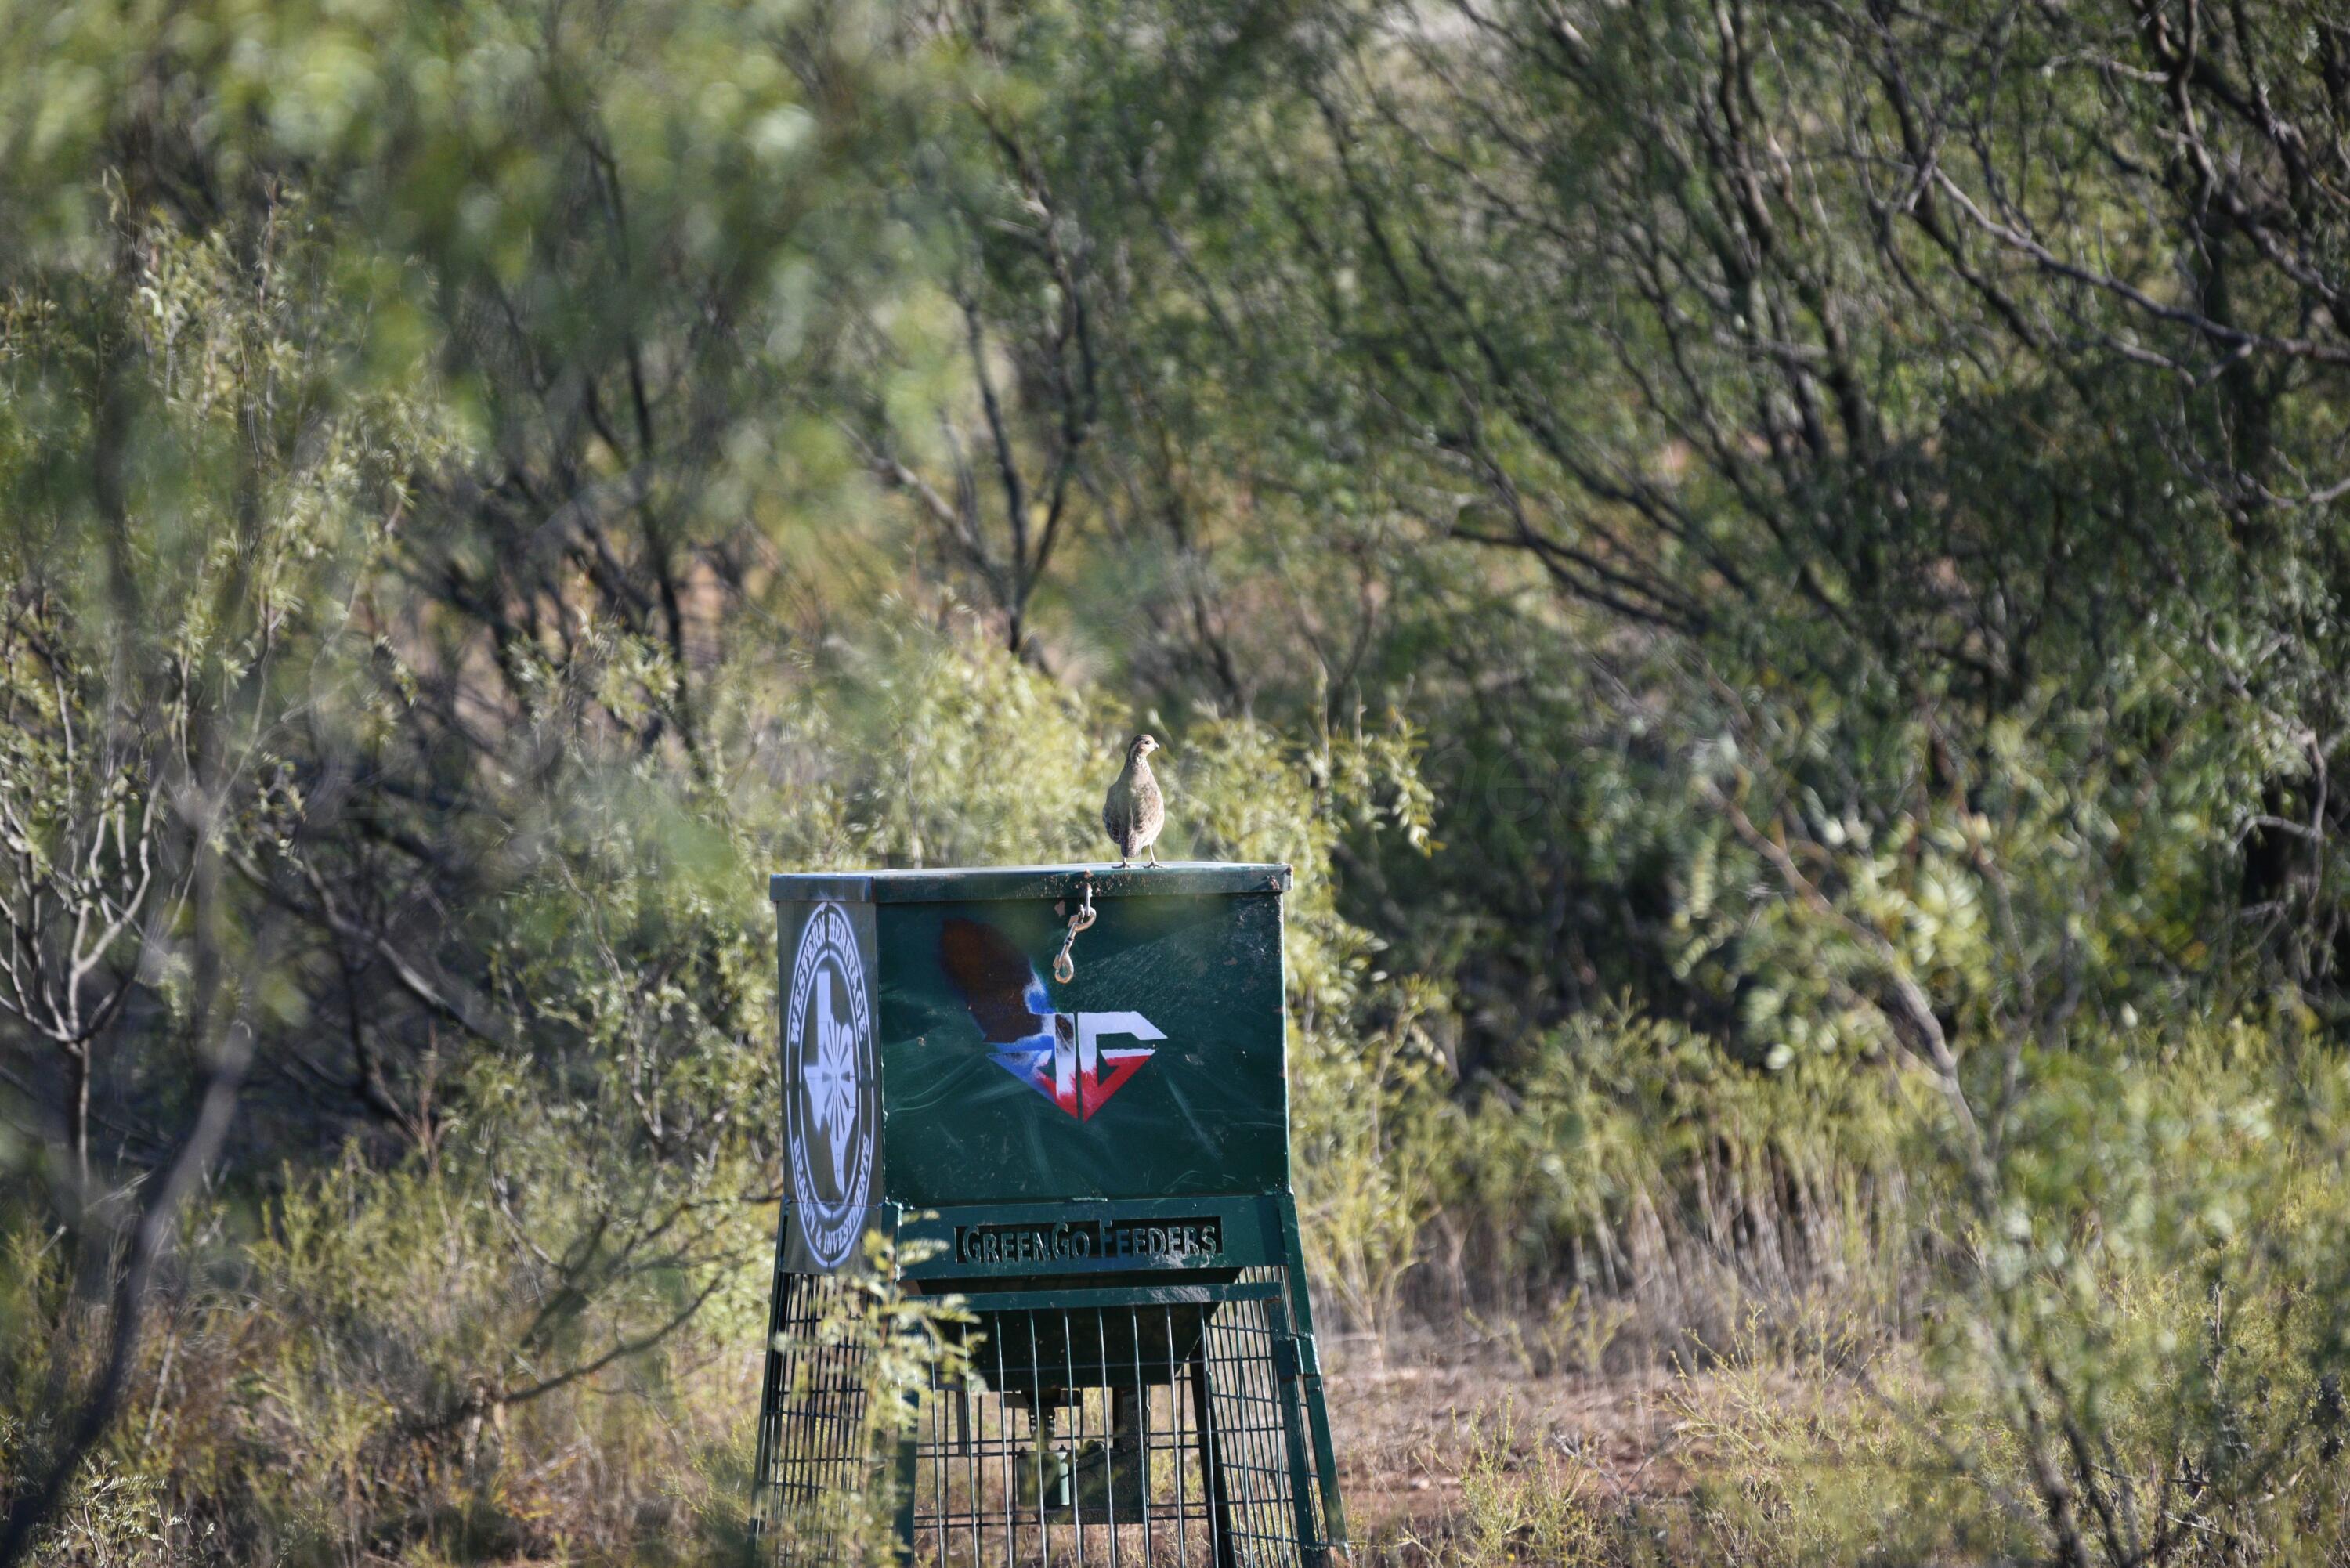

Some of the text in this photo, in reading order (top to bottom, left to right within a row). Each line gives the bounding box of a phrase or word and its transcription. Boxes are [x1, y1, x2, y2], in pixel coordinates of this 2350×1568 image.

[790, 912, 866, 1043] WESTERN HERITAGE
[815, 1224, 822, 1250] &
